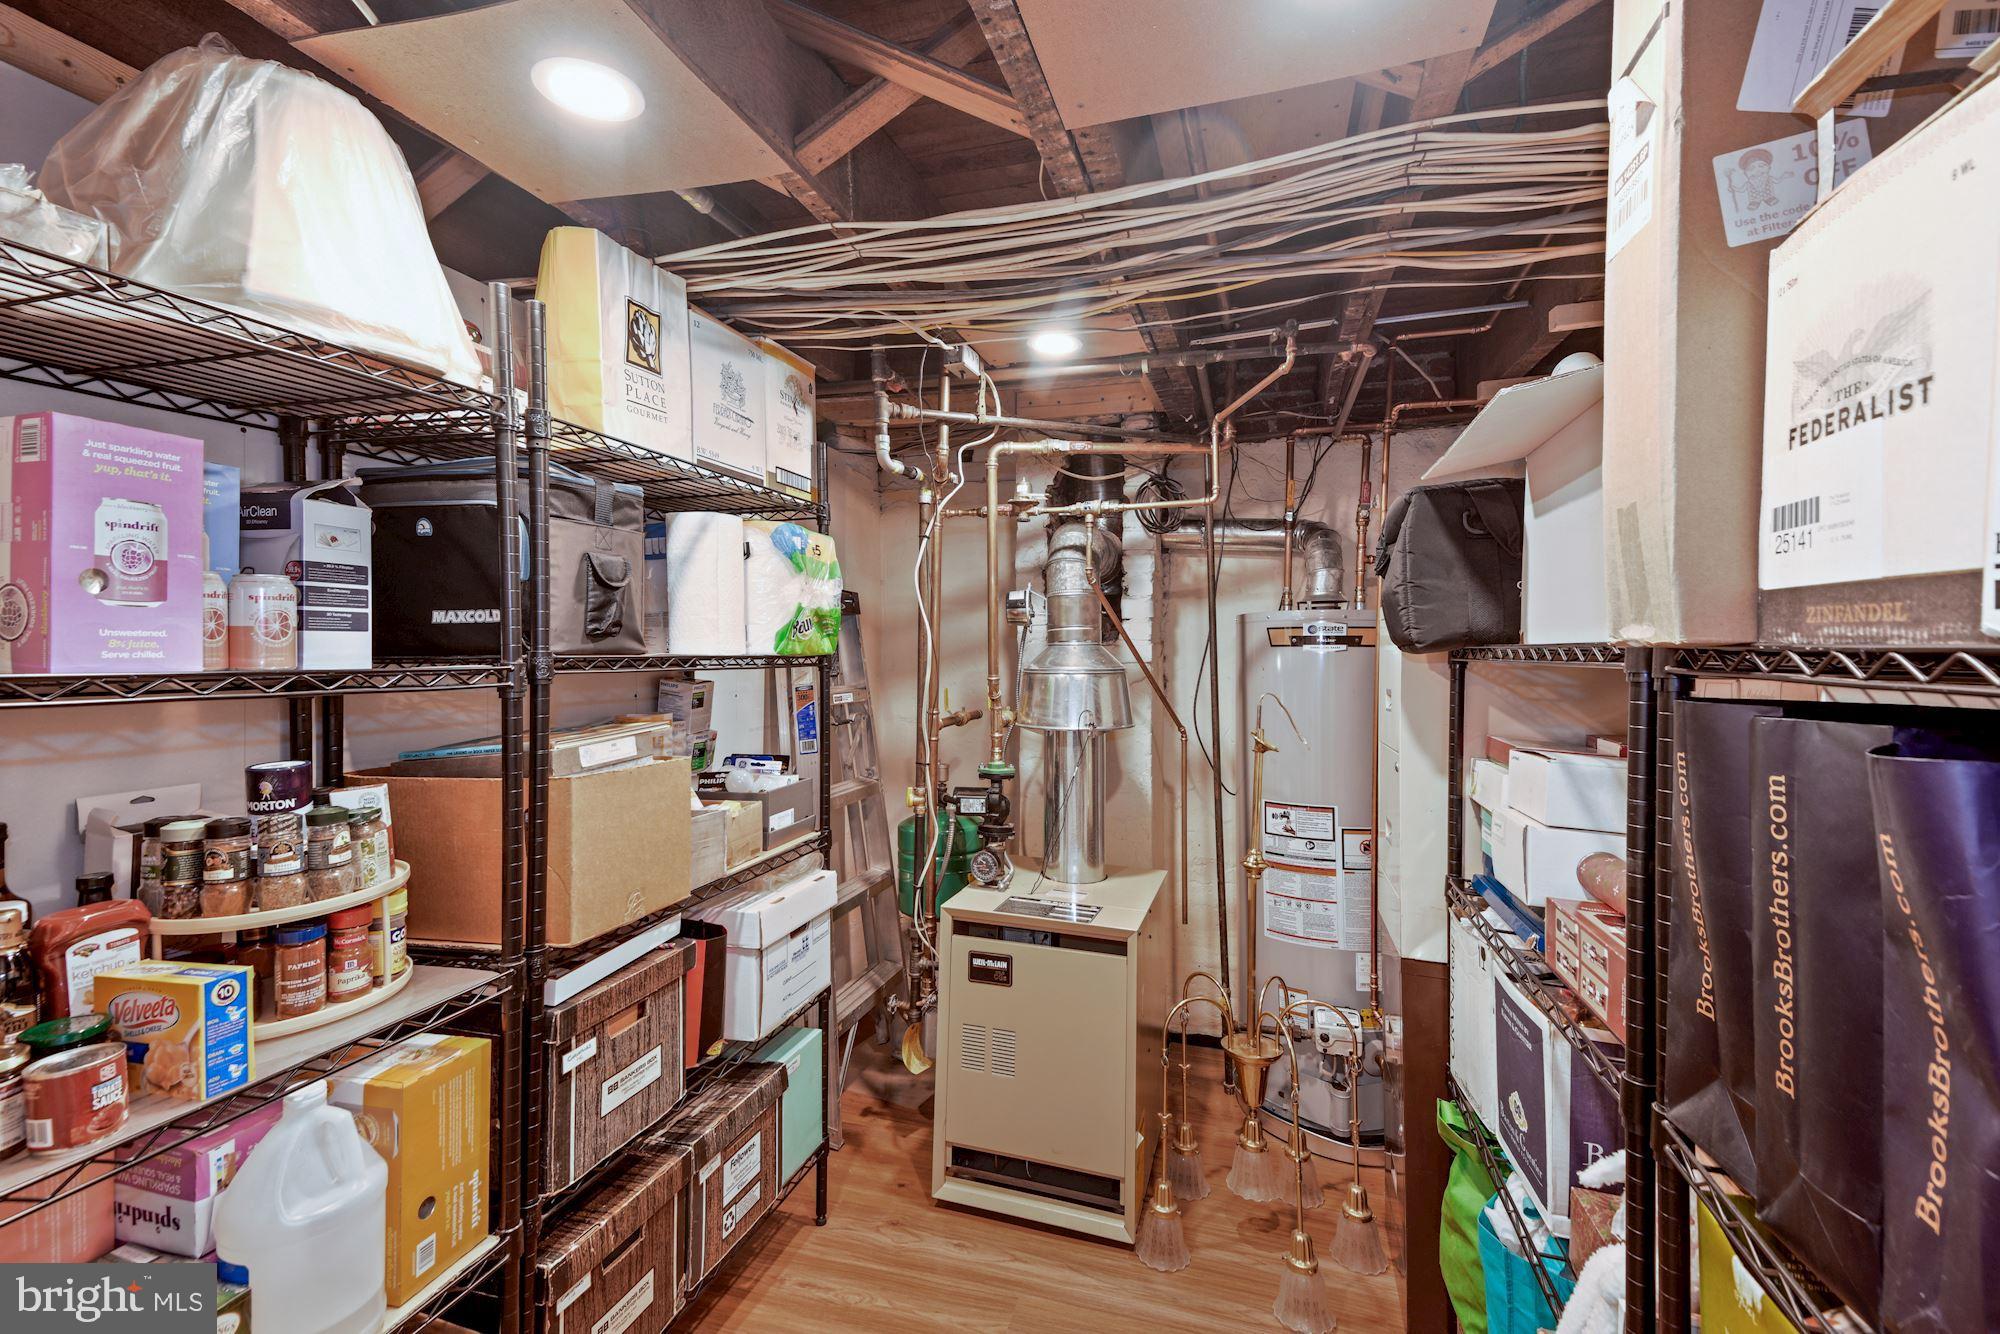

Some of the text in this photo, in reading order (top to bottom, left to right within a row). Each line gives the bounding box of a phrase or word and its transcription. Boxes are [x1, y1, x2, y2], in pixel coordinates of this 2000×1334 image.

[1734, 204, 1811, 228] Use the code
[1746, 227, 1759, 237] at
[624, 368, 665, 394] SUTTON
[1833, 381, 1862, 402] THE
[626, 383, 667, 409] PLACE
[626, 404, 668, 424] GOURMET
[1788, 374, 1934, 451] FEDERALIST
[82, 449, 184, 472] & real squeezed fruit.
[85, 440, 182, 462] Just sparkling water
[94, 463, 173, 482] yup, that's it.
[104, 518, 160, 533] spindrift
[1775, 529, 1812, 555] 25141
[431, 608, 501, 625] MAXCOLD
[1805, 601, 1909, 624] ZINFANDEL
[99, 628, 168, 638] Unsweetened.
[101, 650, 166, 659] Serve chilled.
[108, 639, 160, 651] 8% juice.
[660, 681, 679, 689] PHILIPS
[248, 797, 298, 812] MORTON
[1674, 751, 1716, 1022] BrooksBrothers.com
[334, 935, 366, 944] McCormick
[1768, 774, 1795, 1100] BrooksBrothers.com
[72, 957, 125, 983] ketchup
[287, 958, 321, 971] PAPRIKA
[337, 973, 366, 985] Paprika
[217, 985, 234, 999] 10
[113, 996, 176, 1025] Velveeta
[1880, 833, 1951, 1235] BrooksBrothers.com
[92, 1078, 123, 1099] TOMATO
[92, 1088, 123, 1111] SAUCE
[131, 1174, 181, 1196] SPARKLING
[157, 1172, 176, 1183] REAL
[469, 1168, 482, 1229] spindrift
